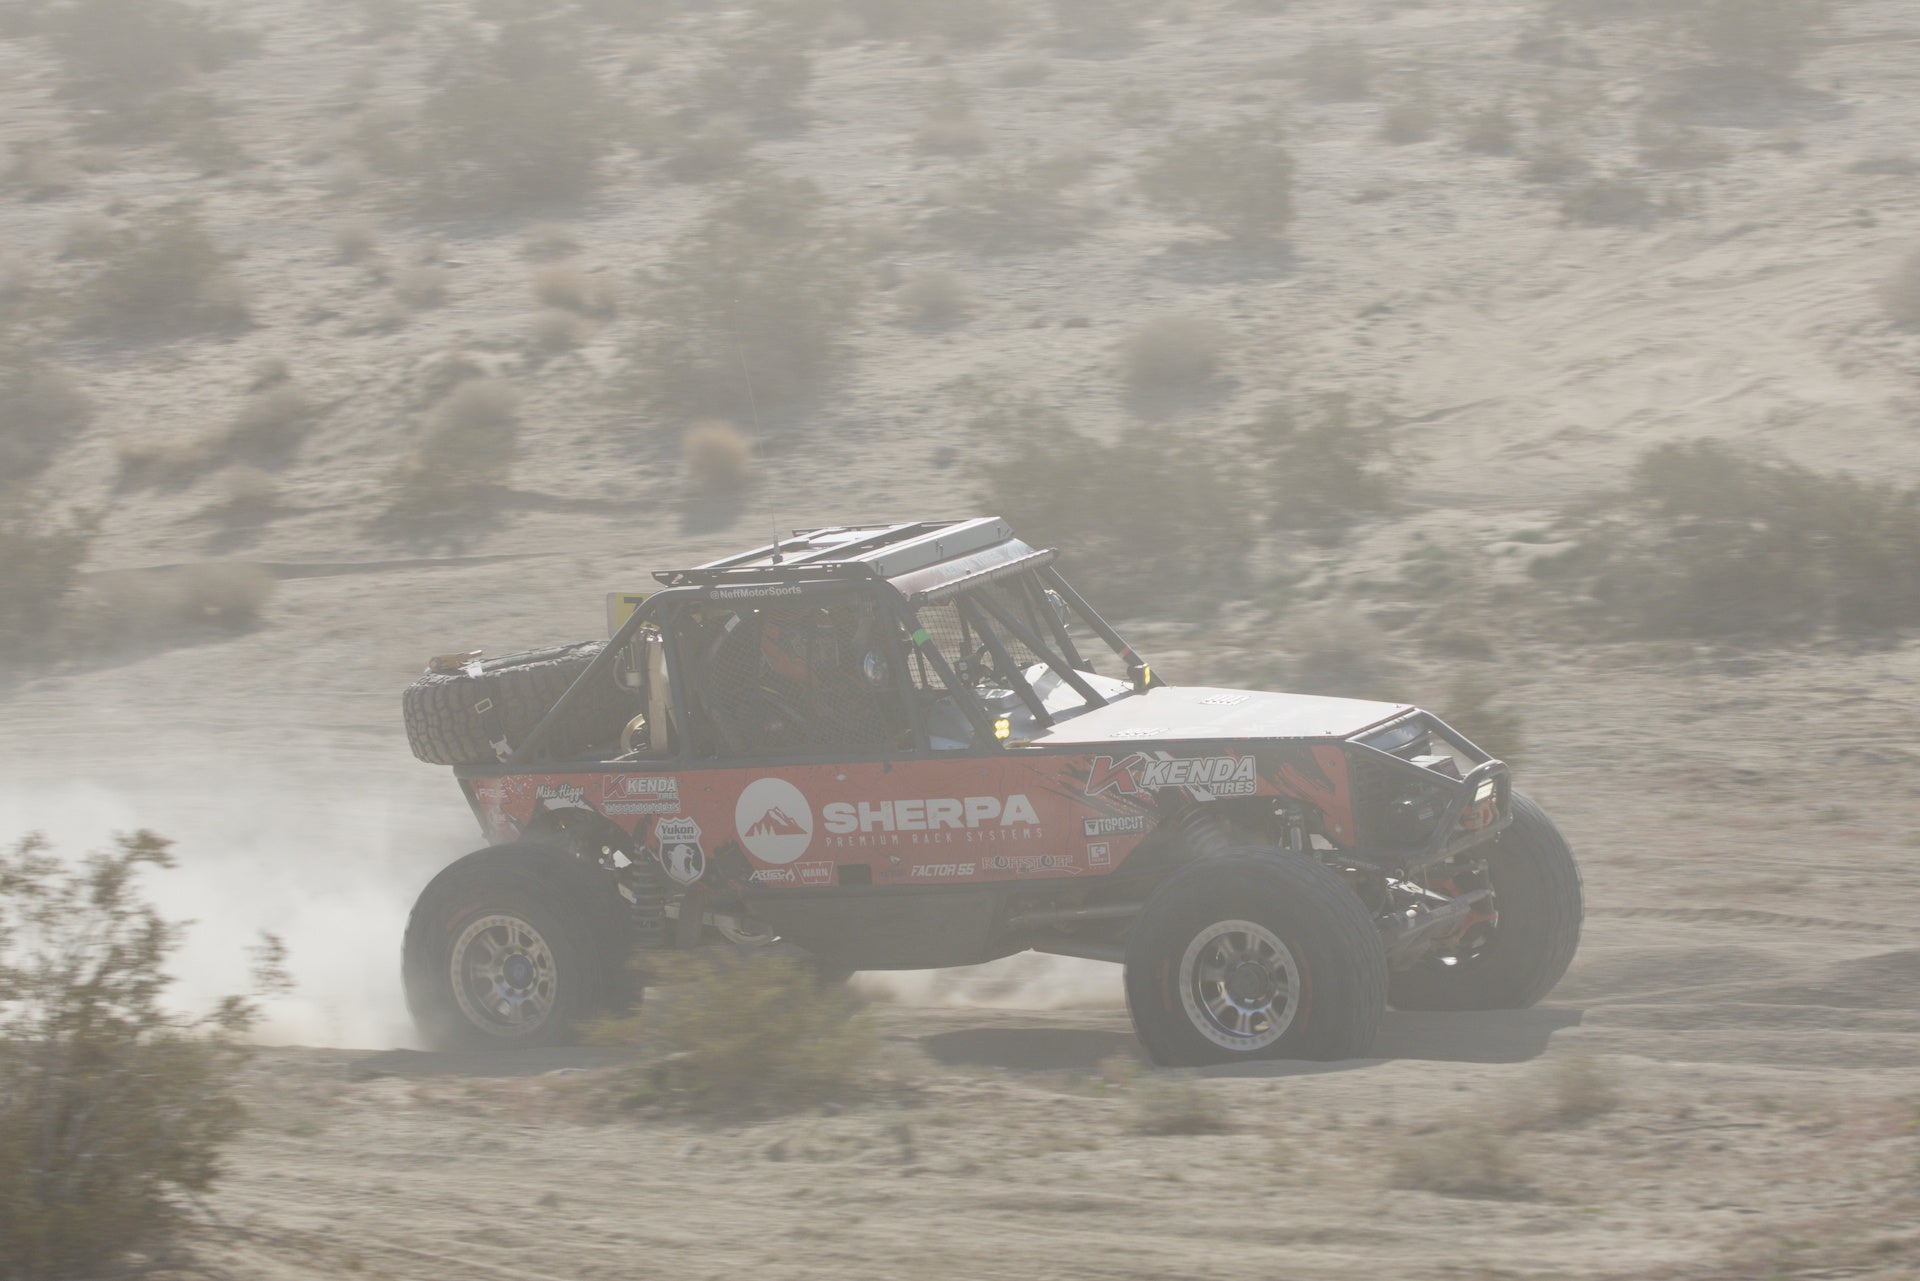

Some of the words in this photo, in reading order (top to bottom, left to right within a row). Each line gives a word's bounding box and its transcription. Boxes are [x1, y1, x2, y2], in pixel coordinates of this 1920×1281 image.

[709, 585, 802, 601] @NeffMotorSports
[1141, 756, 1255, 786] KENDA
[535, 784, 558, 800] Mike
[558, 783, 584, 803] Higgs
[626, 777, 677, 794] KENDA
[1210, 781, 1255, 796] TIRES
[822, 794, 1041, 834] SHERPA
[661, 824, 694, 835] Yukon
[1099, 816, 1145, 832] TOPOCUT
[825, 834, 899, 848] PREMIUM
[912, 831, 953, 845] RACK
[966, 828, 1043, 842] SYSTEMS
[911, 864, 956, 877] FACTOR
[956, 863, 976, 876] 55
